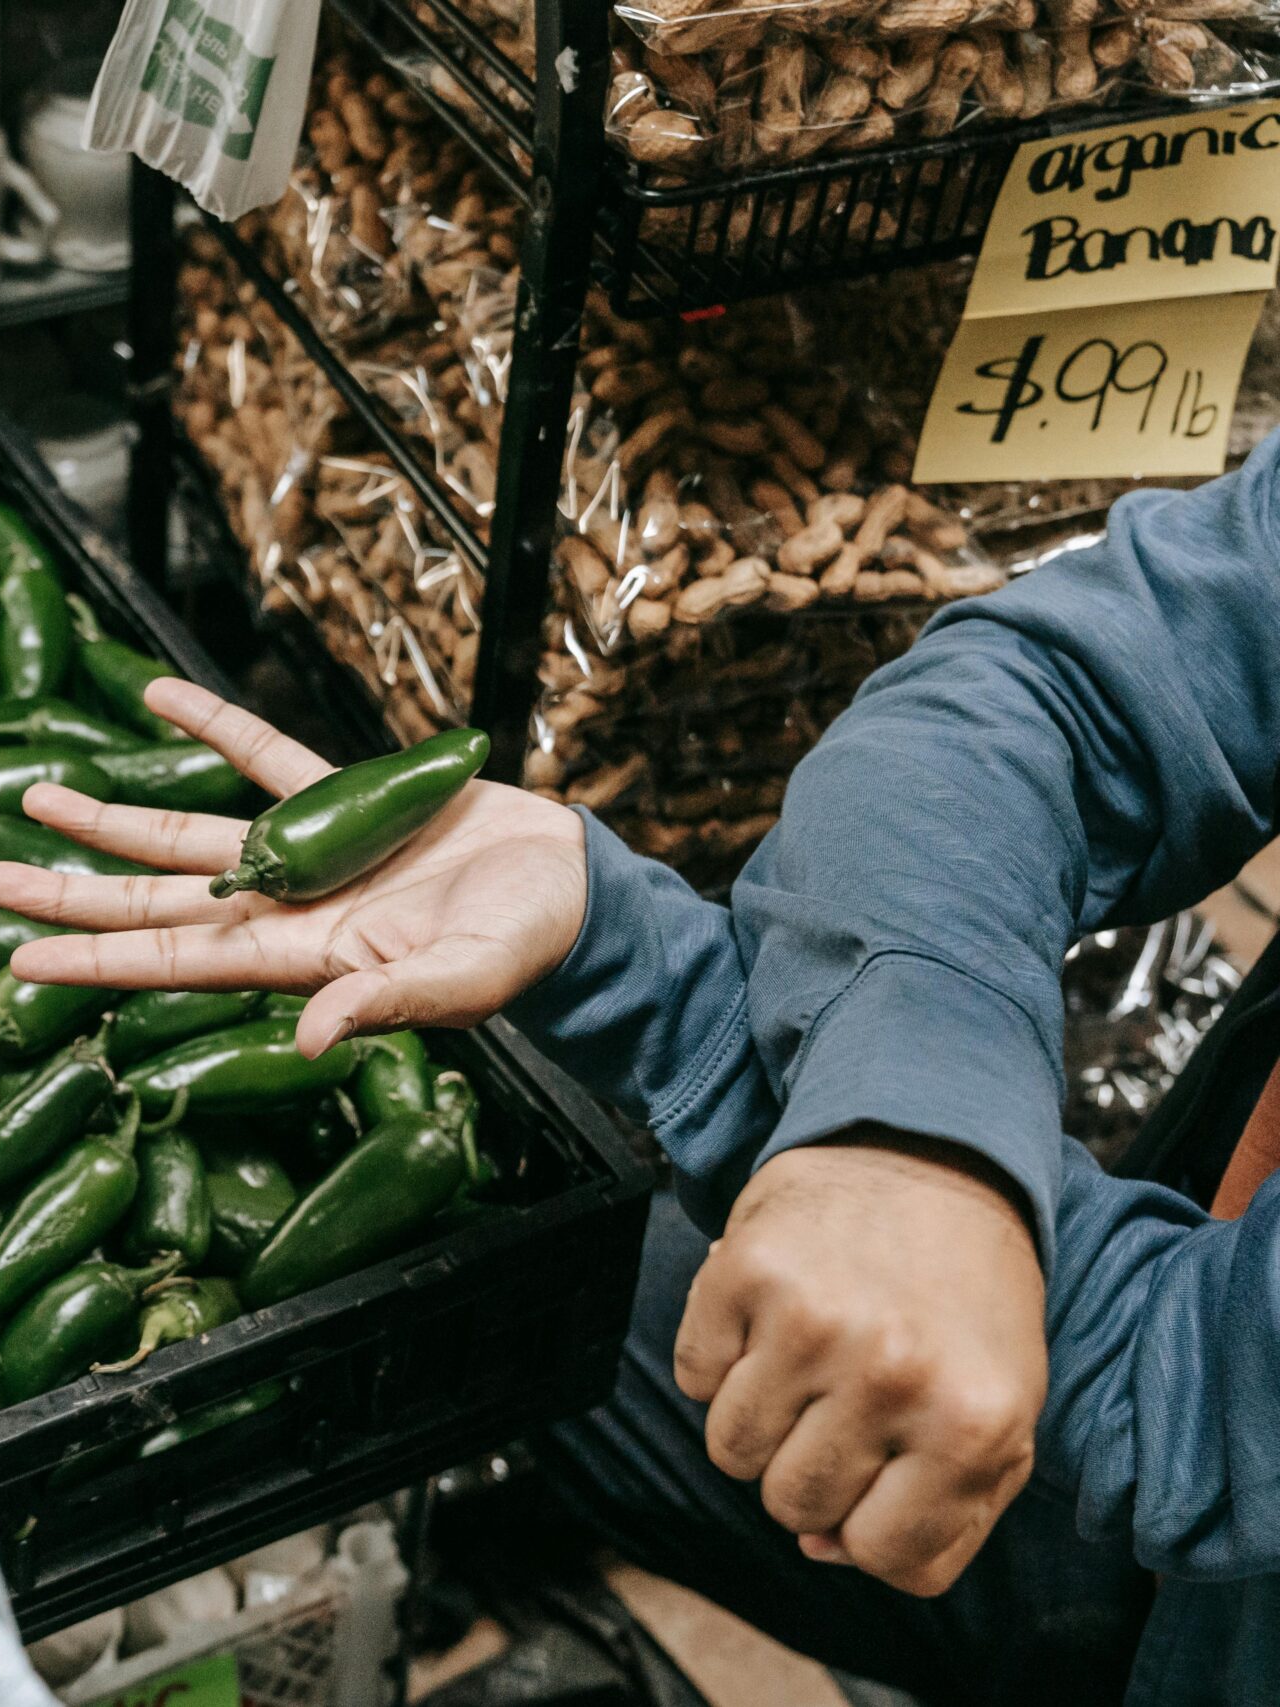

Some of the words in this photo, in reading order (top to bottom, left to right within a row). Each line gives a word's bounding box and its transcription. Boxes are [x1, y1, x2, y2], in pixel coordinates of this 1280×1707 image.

[1021, 216, 1276, 280] Banana
[955, 334, 1169, 443] $.99
[1170, 370, 1218, 437] lb
